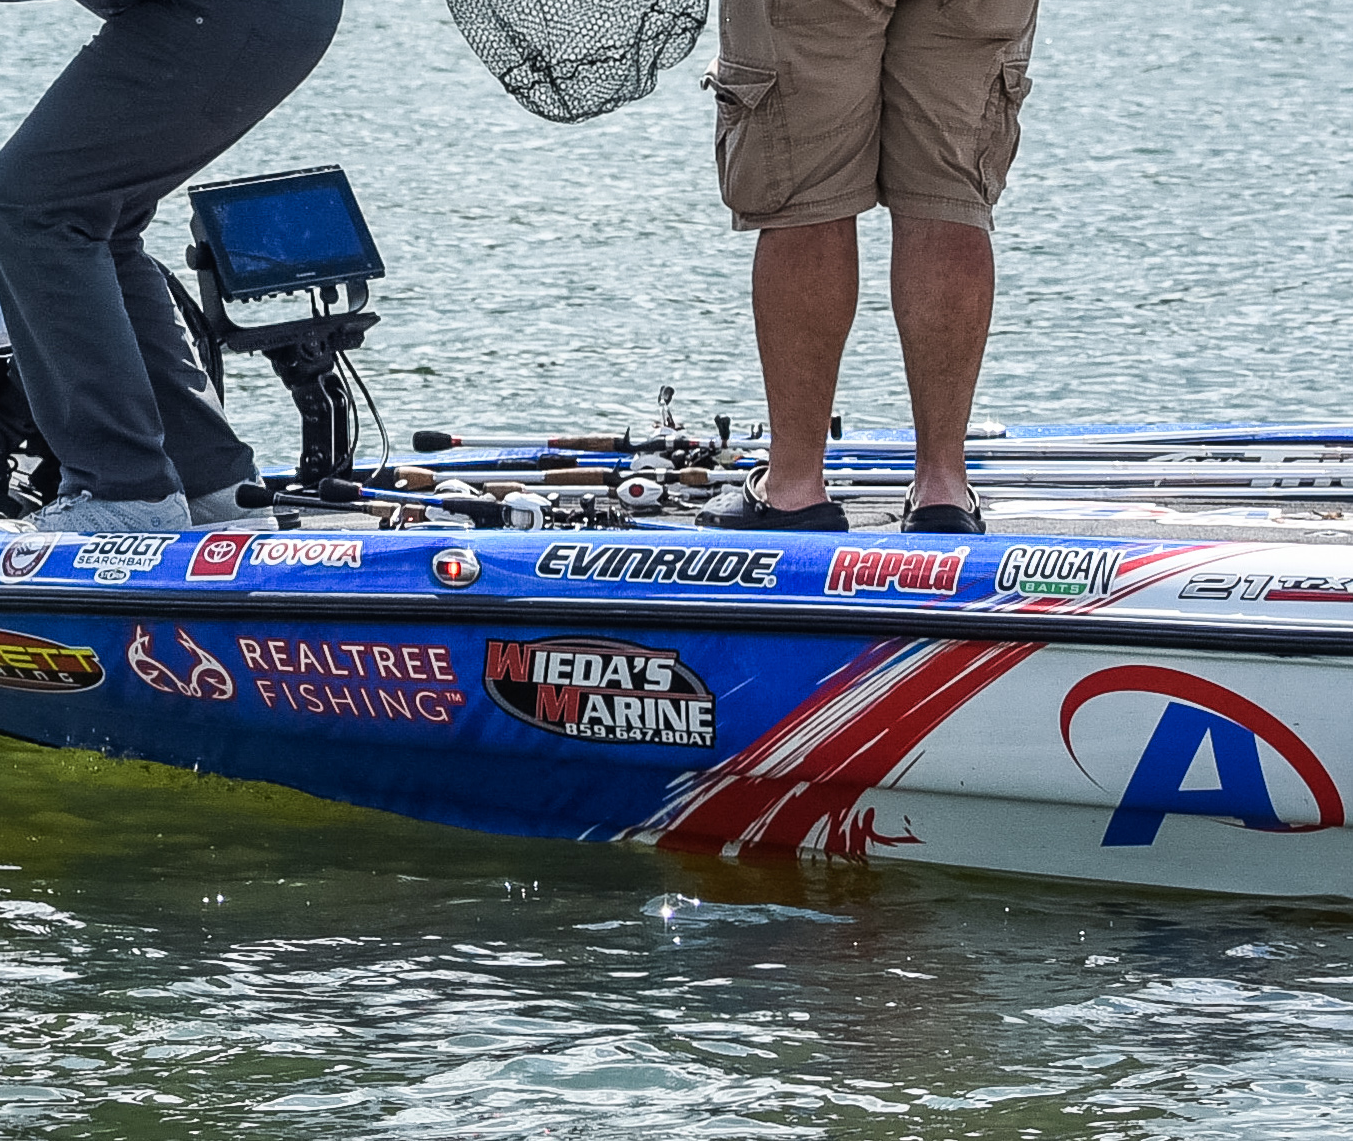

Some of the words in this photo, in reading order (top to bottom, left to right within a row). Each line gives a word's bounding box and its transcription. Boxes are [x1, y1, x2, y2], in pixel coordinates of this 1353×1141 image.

[77, 555, 155, 567] SEARCHBAIT
[255, 541, 358, 564] TOYOTA
[539, 545, 781, 585] EVINRUDE
[997, 548, 1122, 595] GOOGAN
[1025, 581, 1080, 594] BAITS
[238, 638, 454, 681] REALTREE
[485, 641, 676, 692] WIEDA'S
[535, 684, 714, 733] MARINE
[565, 722, 714, 747] 859.647.BOAT
